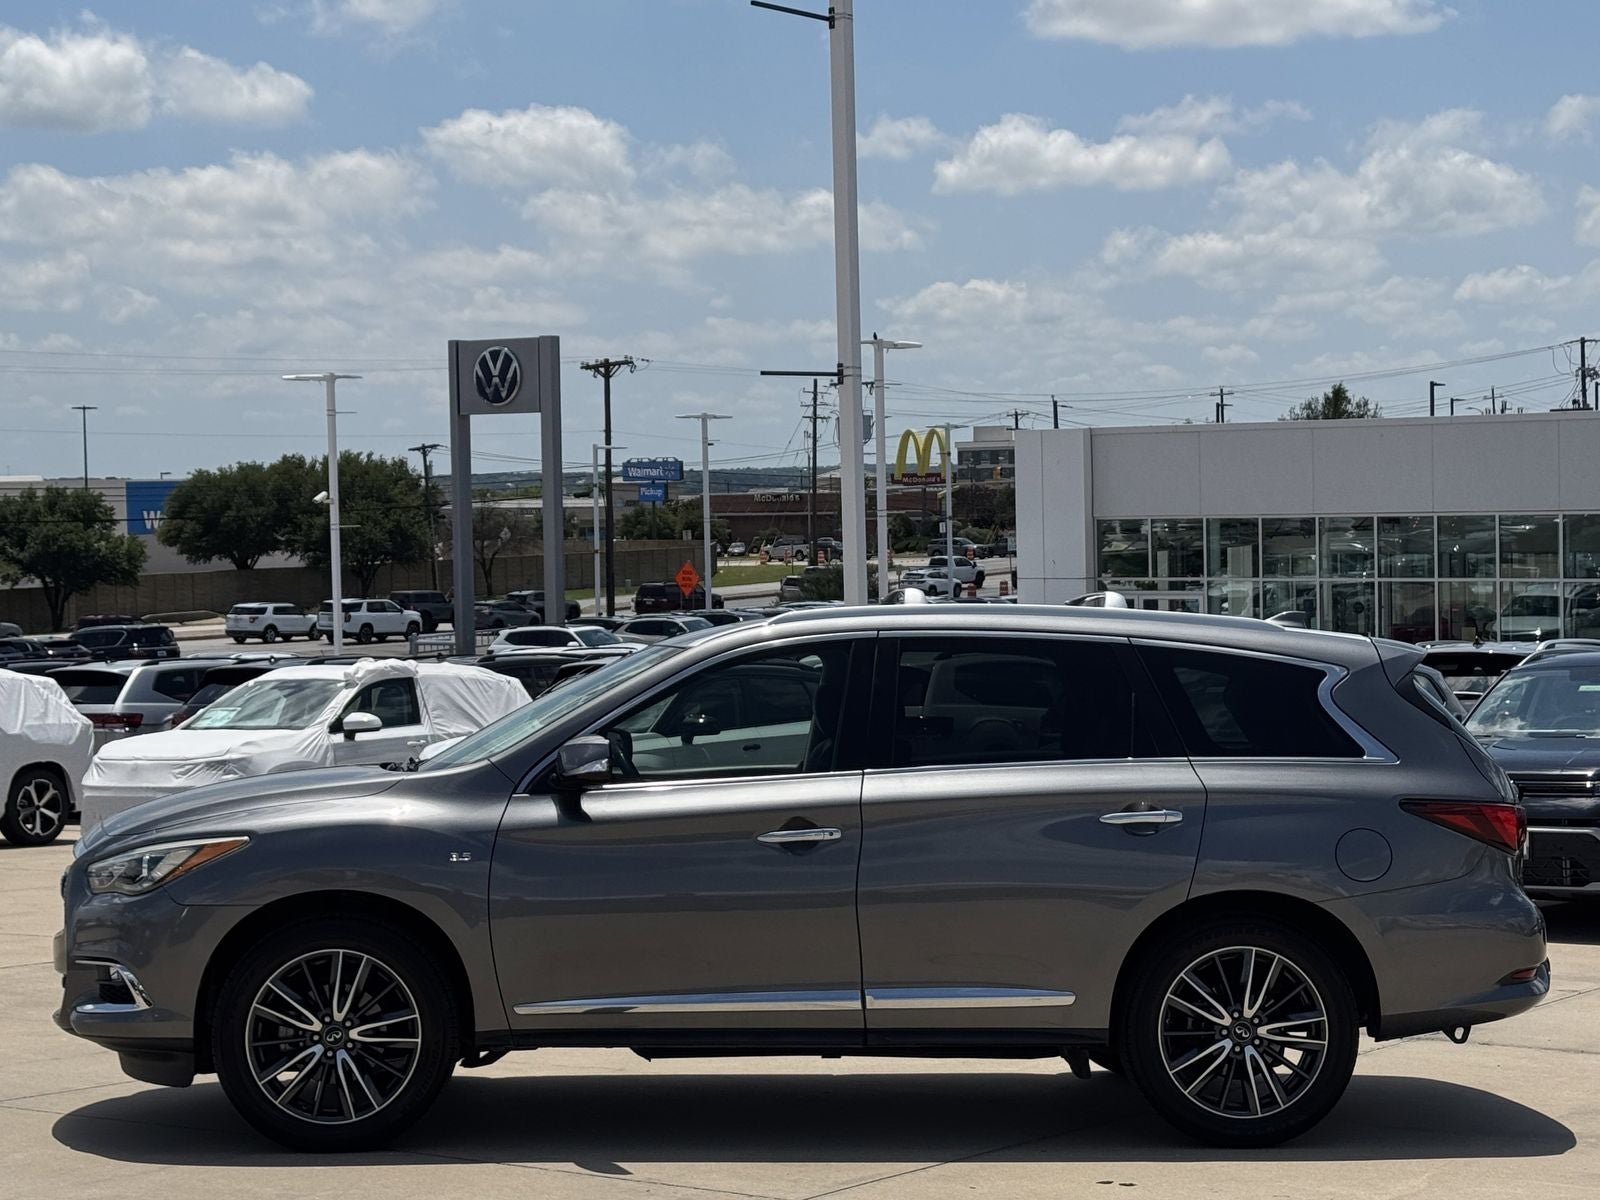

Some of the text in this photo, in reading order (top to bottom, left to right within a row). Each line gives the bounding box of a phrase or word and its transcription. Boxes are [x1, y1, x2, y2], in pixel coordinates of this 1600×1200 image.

[627, 466, 664, 477] Walmart
[640, 487, 663, 497] Pickup
[450, 852, 471, 862] 3.5
